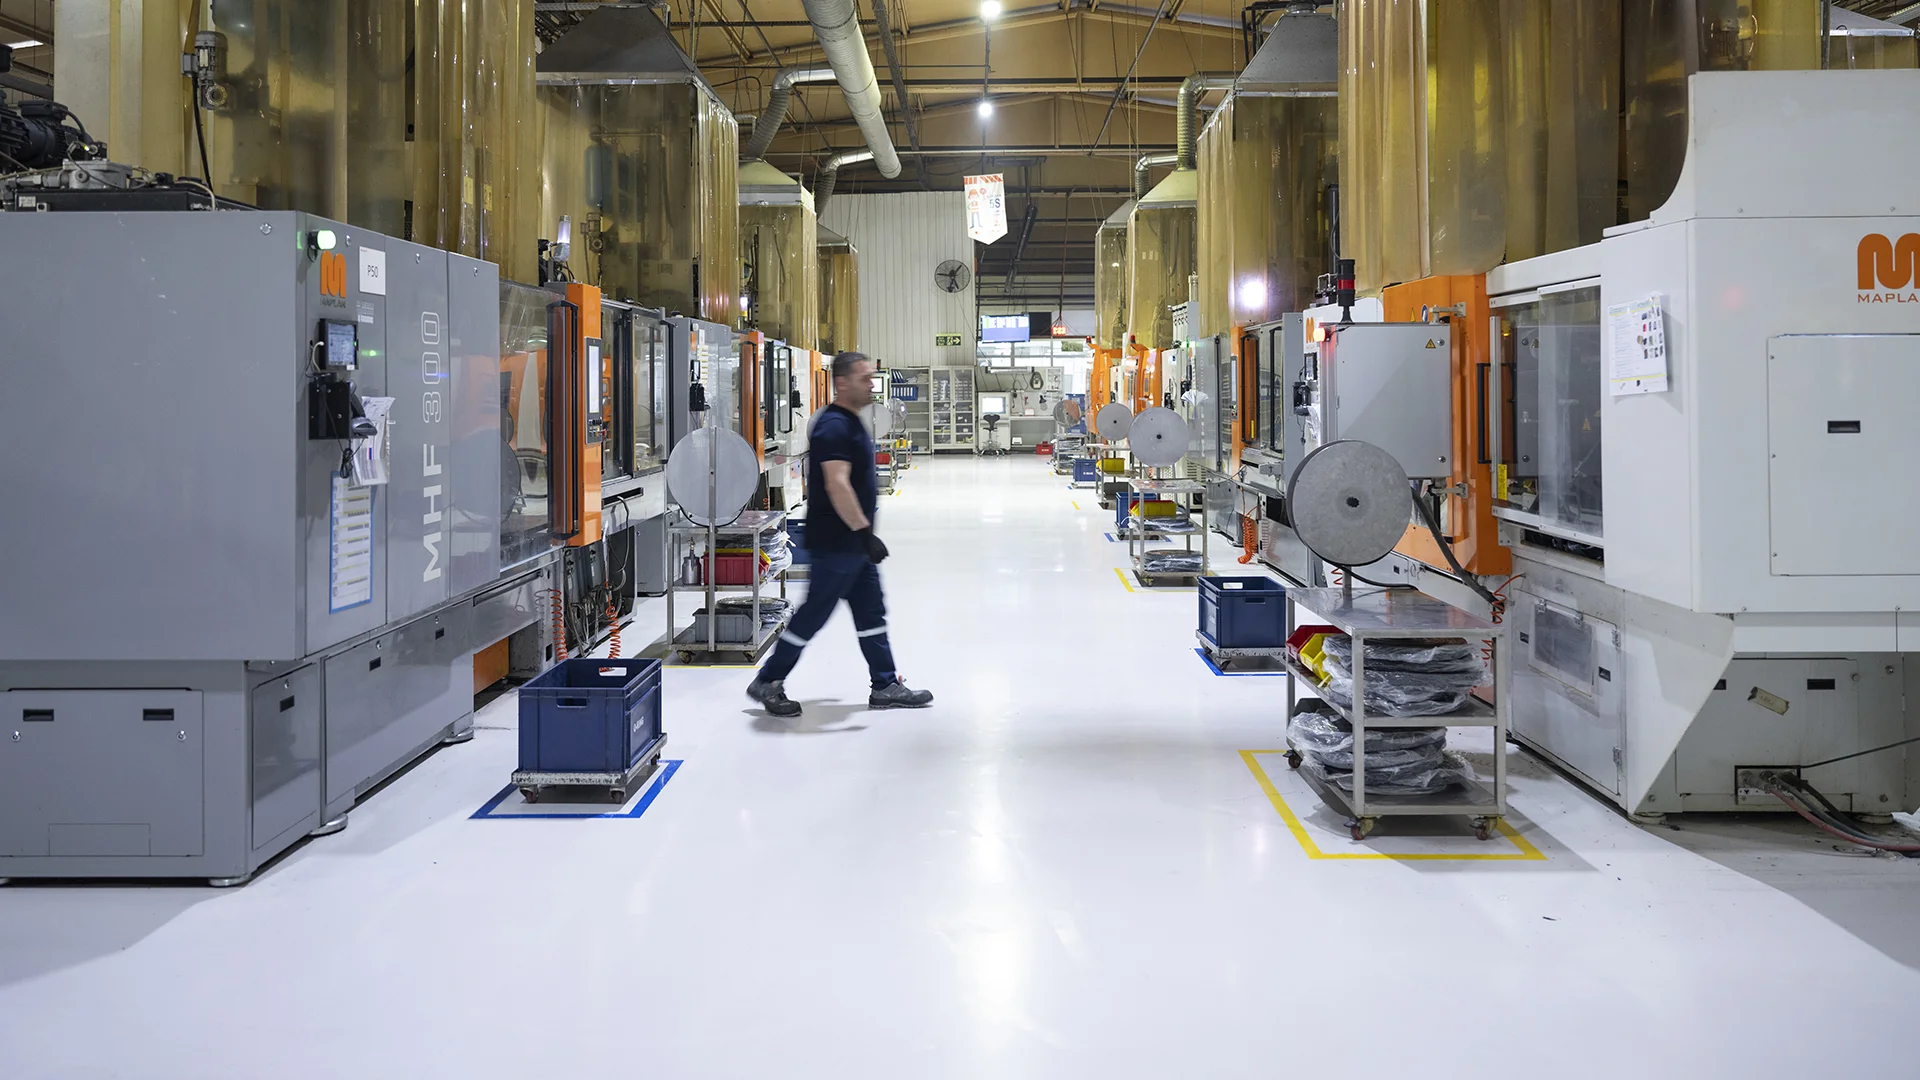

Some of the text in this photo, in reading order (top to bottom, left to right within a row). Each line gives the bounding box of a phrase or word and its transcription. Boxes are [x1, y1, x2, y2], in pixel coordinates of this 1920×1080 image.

[989, 197, 1001, 209] 5S
[1857, 292, 1919, 304] MAPLA
[421, 311, 442, 583] MHF 300
